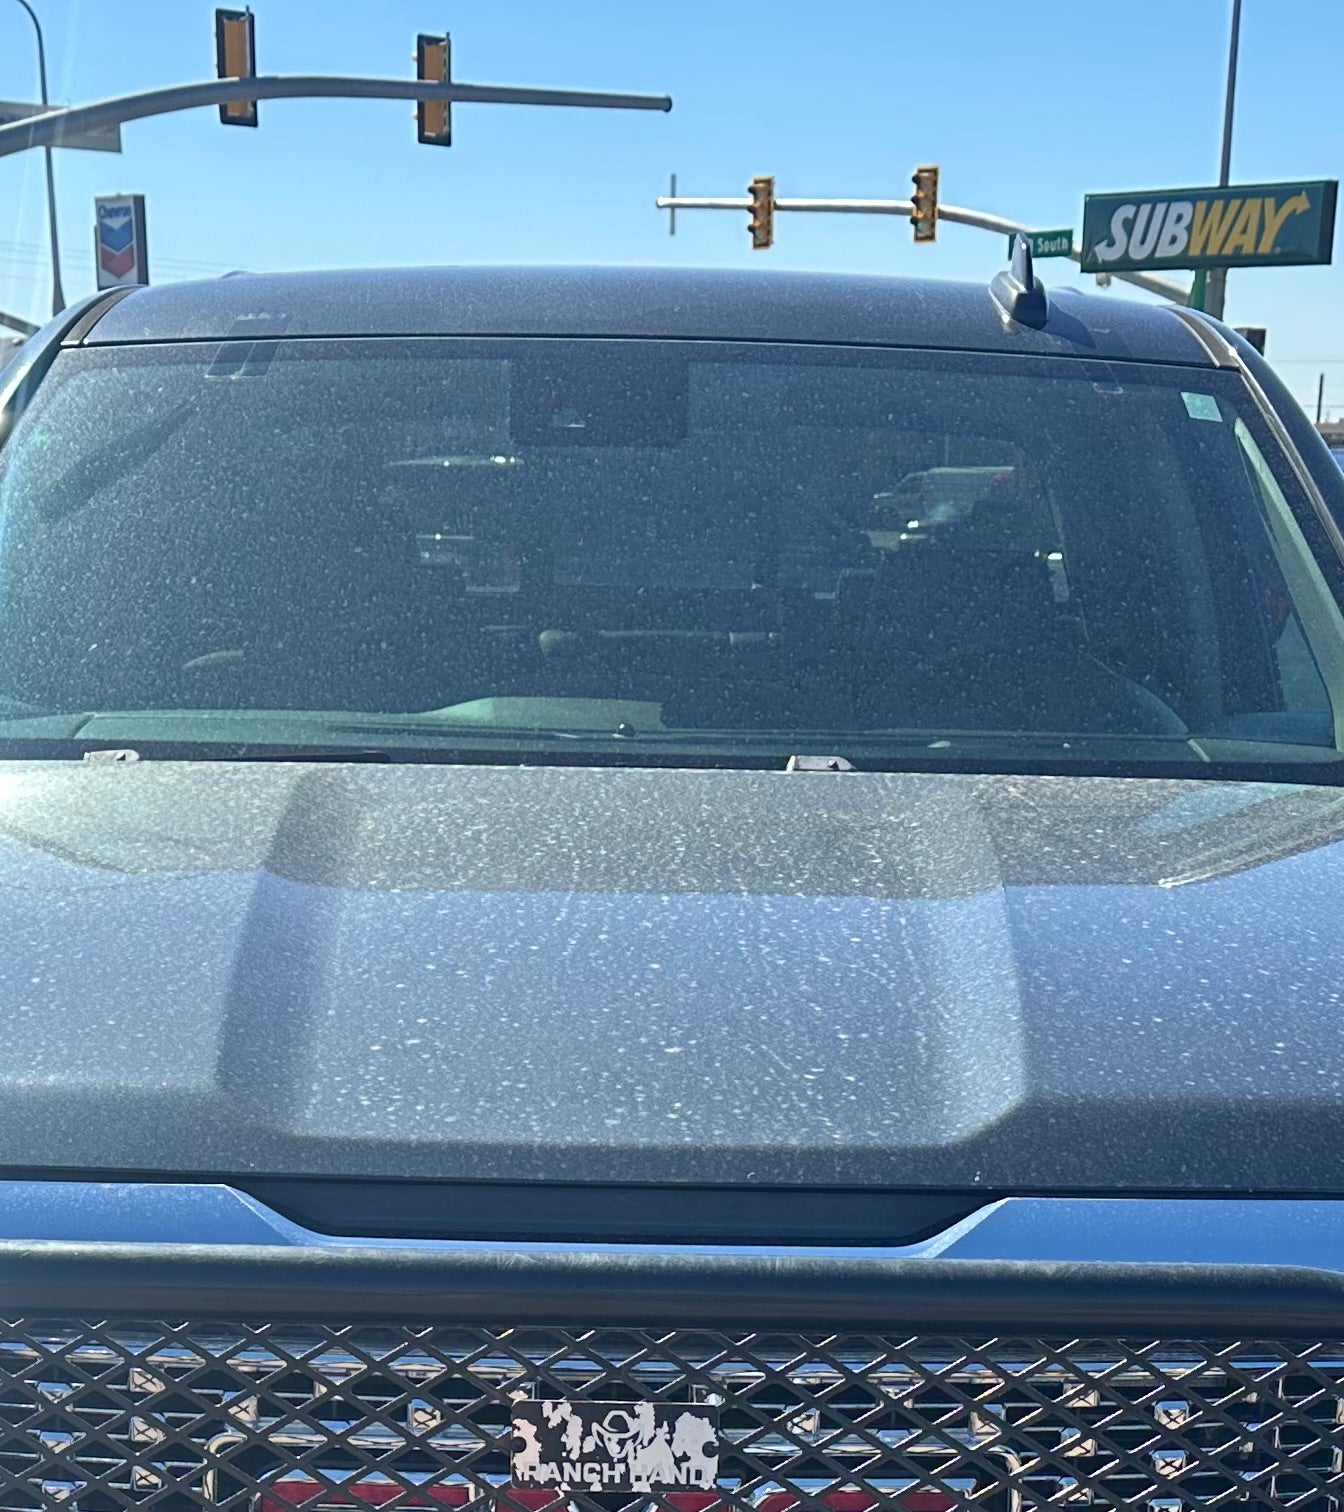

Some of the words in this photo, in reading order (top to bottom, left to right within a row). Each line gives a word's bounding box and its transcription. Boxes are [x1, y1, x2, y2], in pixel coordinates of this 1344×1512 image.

[1094, 191, 1311, 263] SUBWAY
[1037, 236, 1069, 253] South
[523, 1461, 622, 1484] RANCH
[629, 1461, 708, 1485] HAND
